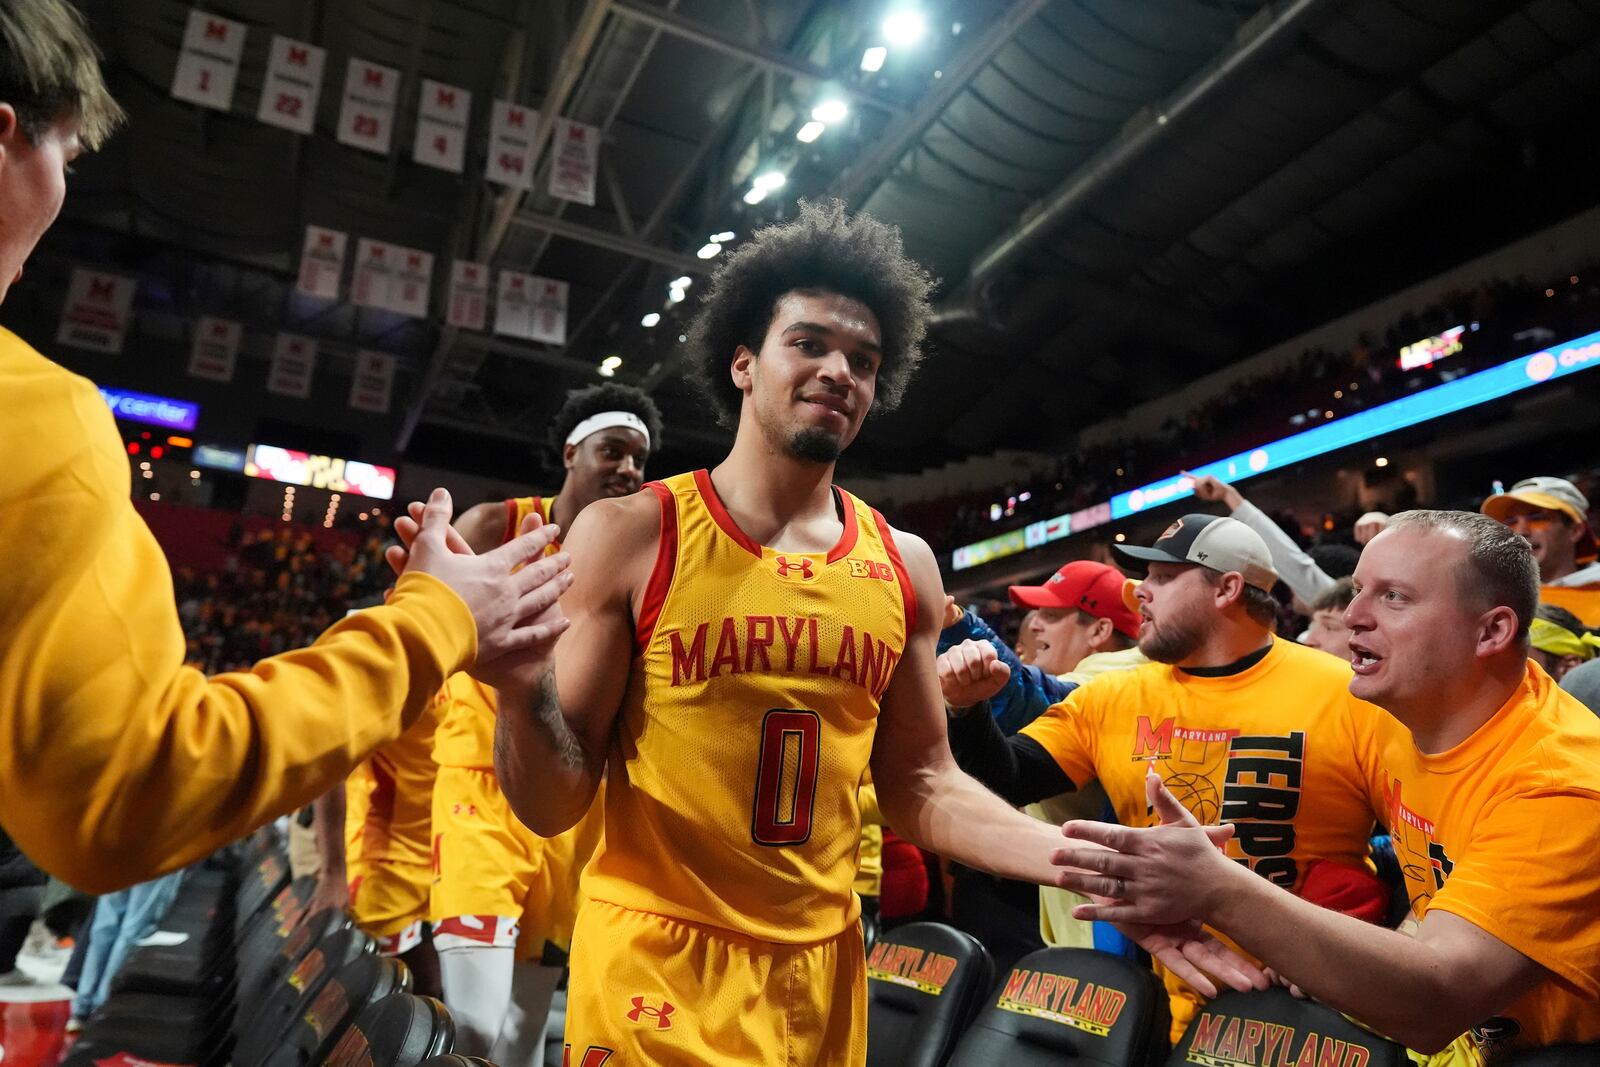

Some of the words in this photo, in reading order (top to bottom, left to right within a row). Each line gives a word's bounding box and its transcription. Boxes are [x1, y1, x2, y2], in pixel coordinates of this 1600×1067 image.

[198, 70, 211, 92] 1
[275, 93, 303, 118] 22
[352, 114, 379, 137] 23
[433, 135, 448, 155] 4
[669, 614, 898, 700] MARYLAND
[1132, 715, 1176, 756] M
[1173, 728, 1227, 742] MARYLAND
[751, 708, 821, 847] 0
[867, 941, 958, 987] MARYLAND
[1001, 968, 1127, 1028] MARYLAND
[1190, 1012, 1370, 1067] MARYLAND
